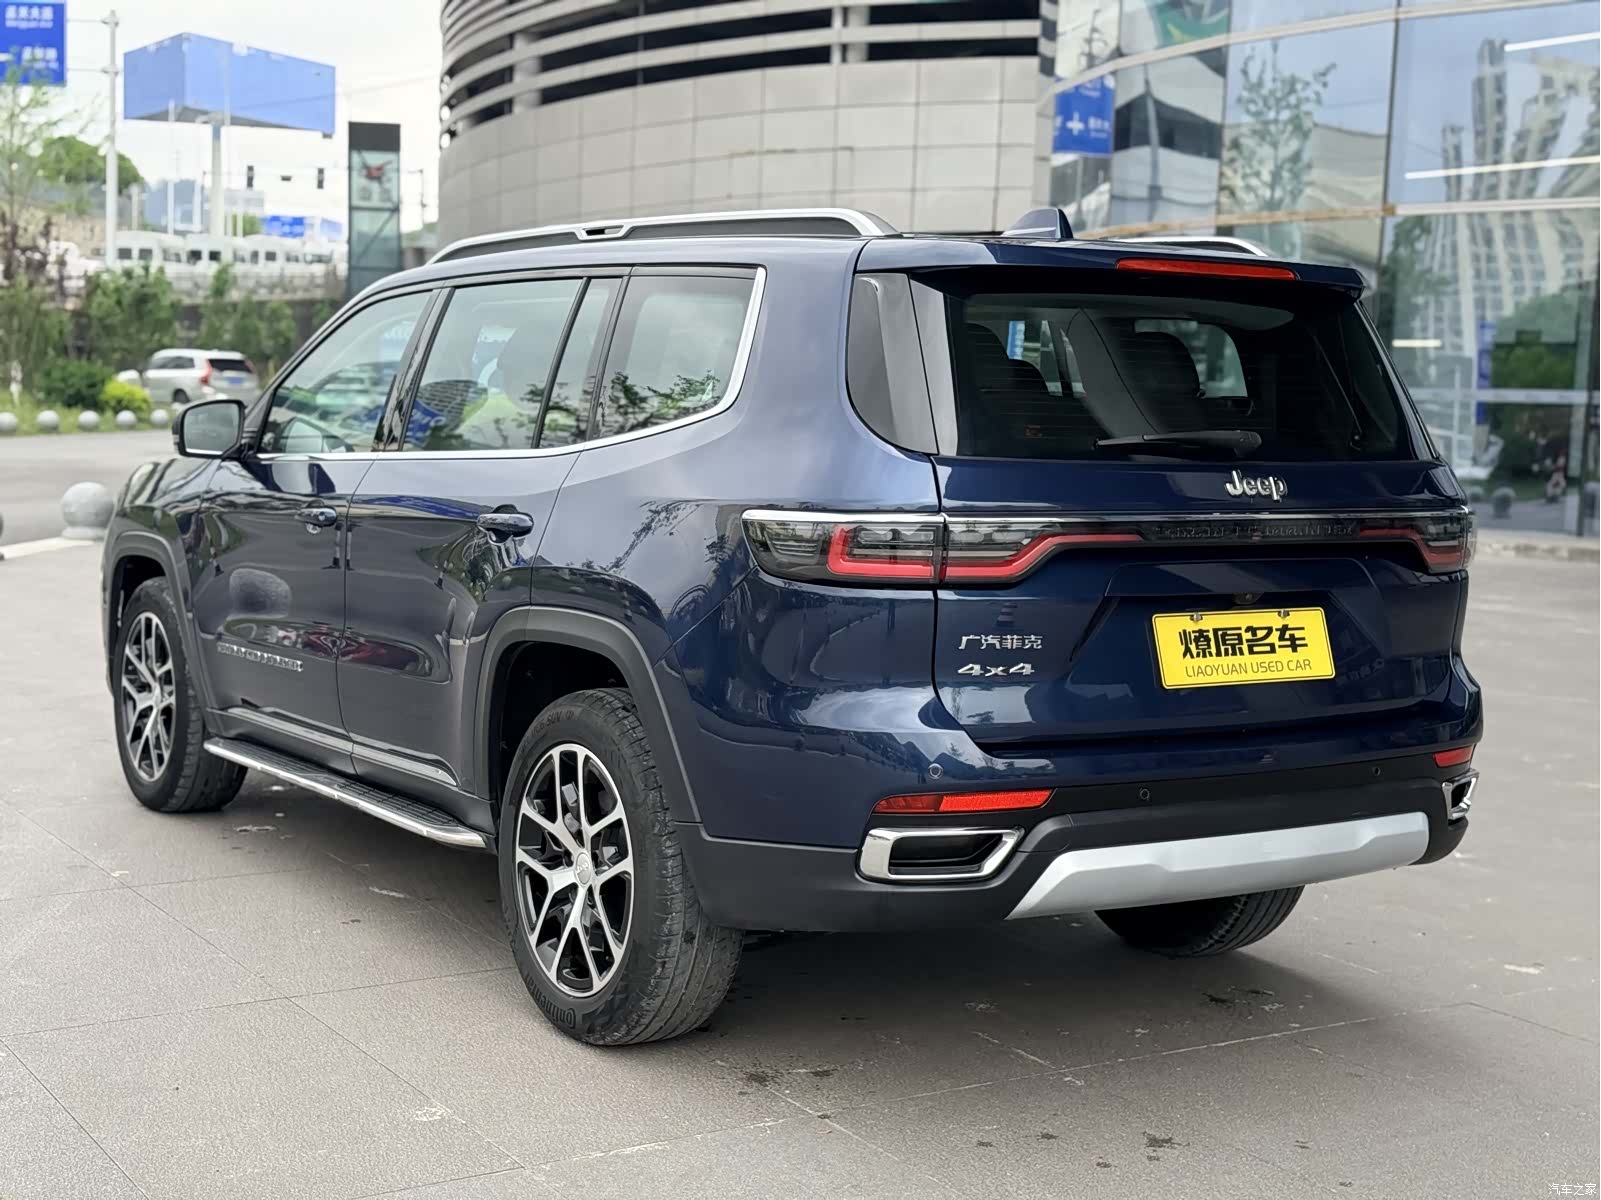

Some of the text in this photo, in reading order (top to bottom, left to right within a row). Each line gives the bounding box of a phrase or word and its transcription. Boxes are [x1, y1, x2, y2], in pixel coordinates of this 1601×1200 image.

[1225, 469, 1288, 502] Jeep
[958, 634, 1043, 650] 广汽菲克
[1178, 624, 1309, 660] 燎原名车
[958, 662, 1035, 676] 4x4
[1185, 658, 1312, 678] LIAOYUAN USED CAR
